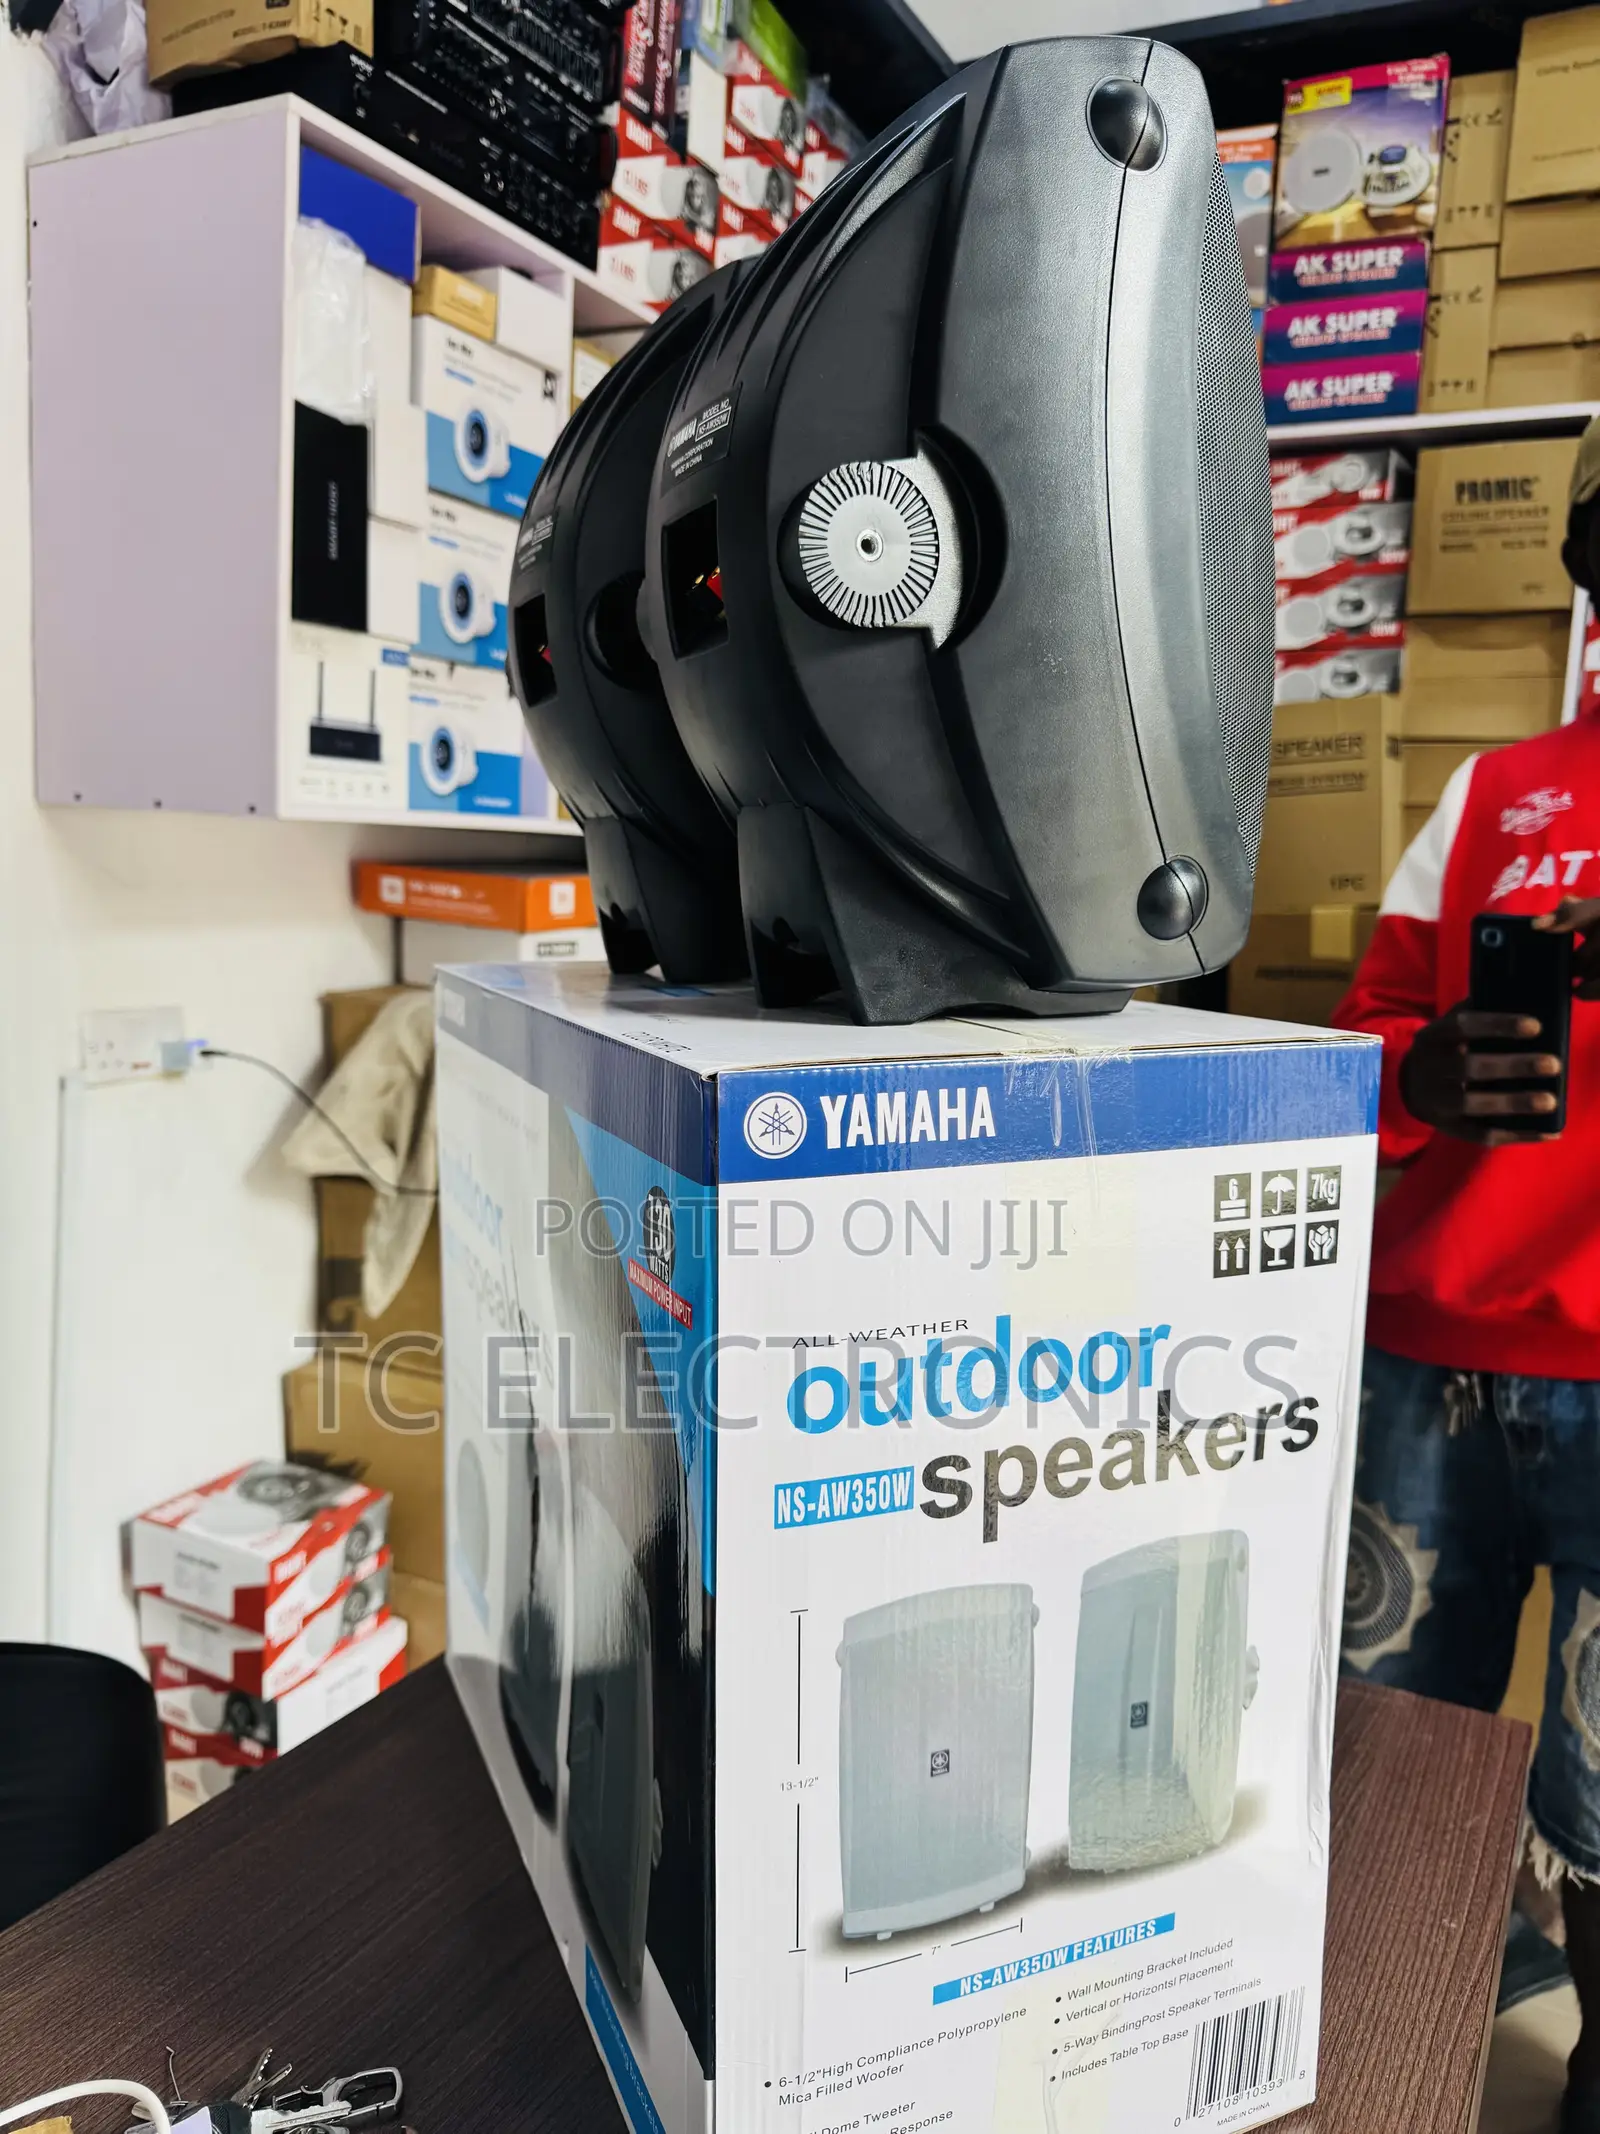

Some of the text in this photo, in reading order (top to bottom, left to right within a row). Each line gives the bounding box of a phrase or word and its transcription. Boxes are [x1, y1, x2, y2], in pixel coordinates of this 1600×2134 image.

[1331, 246, 1404, 273] SUPER
[1325, 306, 1398, 334] SUPER
[1321, 371, 1394, 398] SUPER
[819, 1087, 997, 1150] YAMAHA
[1311, 1173, 1338, 1205] 7kg
[648, 1194, 672, 1261] 130
[629, 1261, 692, 1327] MAXIMUM POWER INPUT
[649, 1253, 669, 1285] WATTS
[792, 1319, 969, 1349] ALL-WEATHER
[786, 1314, 1172, 1434] outdoor
[918, 1390, 1320, 1543] speakers
[777, 1471, 911, 1525] NS-AW350W
[780, 1776, 820, 1792] 13-1/2"
[959, 1920, 1157, 1996] NS-AW350W FEATURES
[1067, 1938, 1234, 2001] Wall Mounting Bracket Included
[1064, 2032, 1100, 2053] 5-Way
[1168, 1994, 1211, 2017] Speaker
[1214, 1977, 1262, 2001] Terminals
[1066, 2001, 1107, 2022] Vertical
[1109, 1998, 1122, 2008] or
[1179, 1959, 1234, 1985] Placement
[779, 2006, 1028, 2088] 6-1/2"High Compliance Polypropylene
[1061, 2027, 1189, 2080] Includes Table Top Base
[779, 2063, 904, 2106] Mica Filled Woofer
[863, 2100, 916, 2125] Tweeter
[890, 2109, 954, 2134] Response
[1217, 2102, 1271, 2126] MADE IN CHINA
